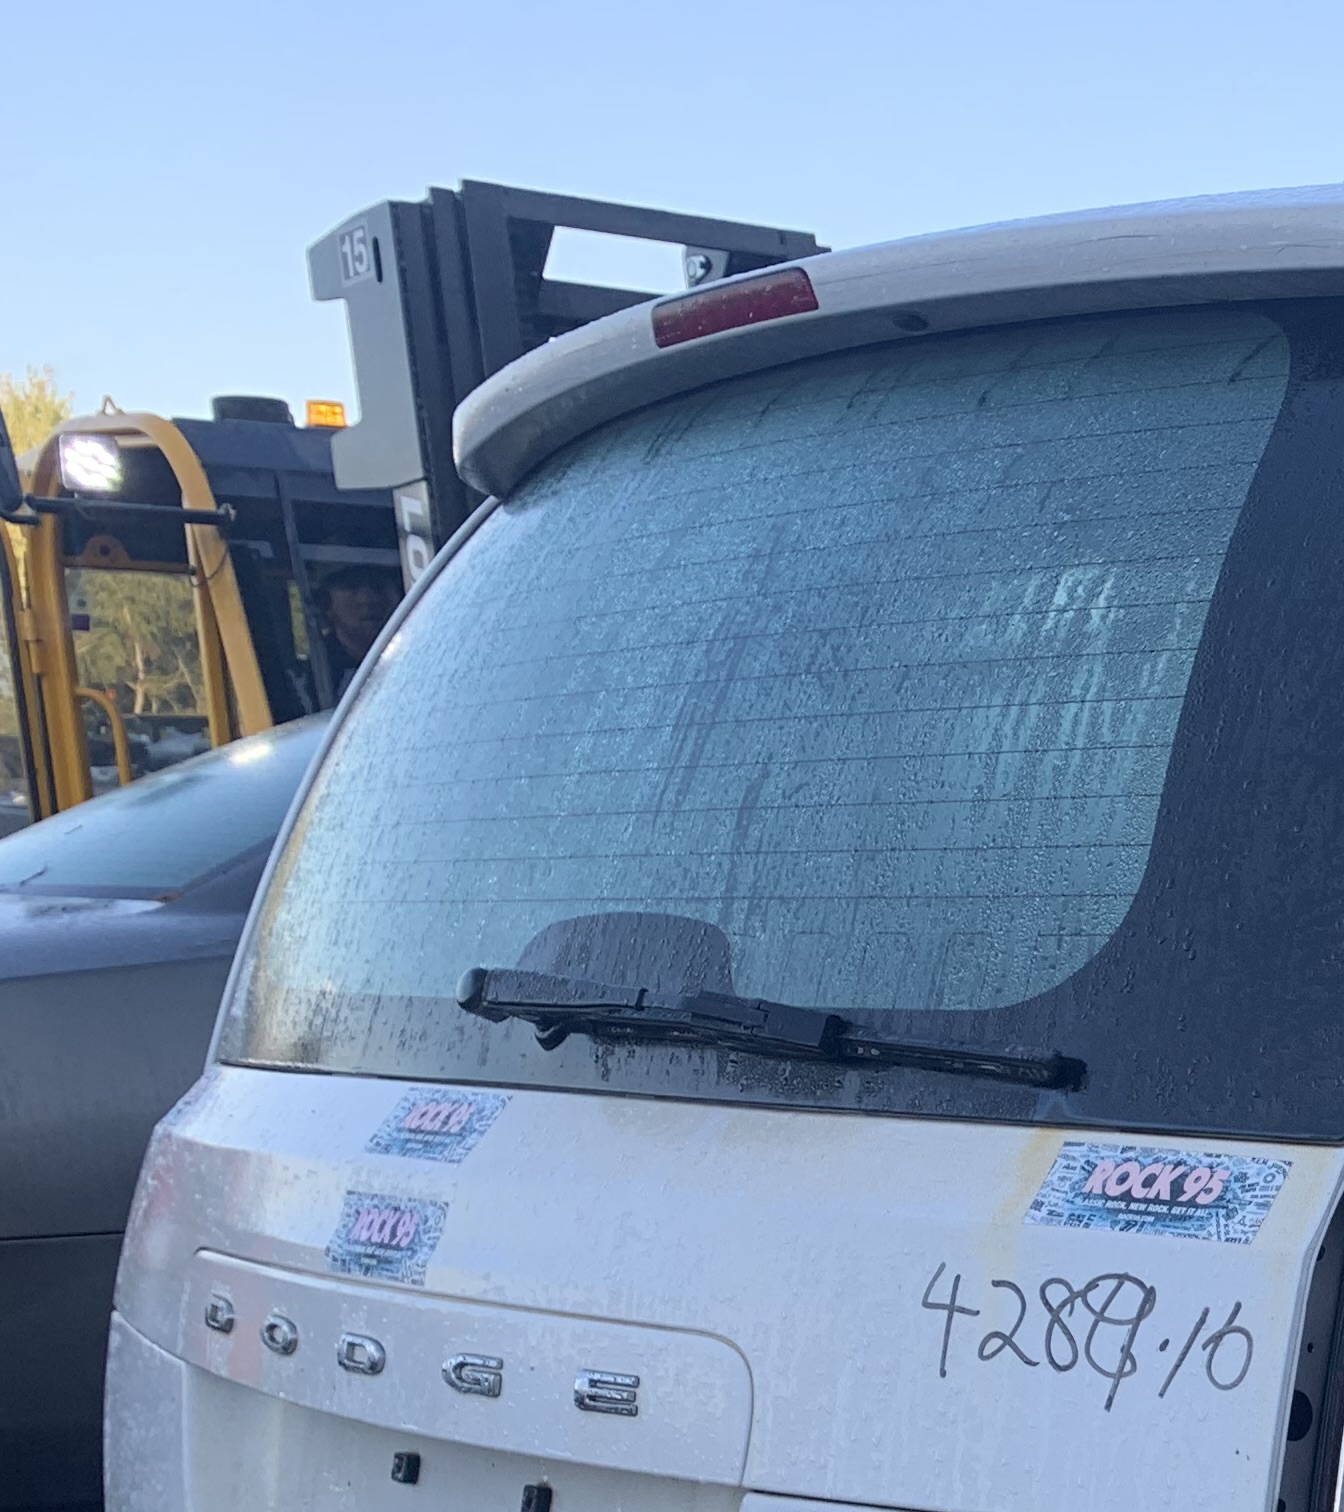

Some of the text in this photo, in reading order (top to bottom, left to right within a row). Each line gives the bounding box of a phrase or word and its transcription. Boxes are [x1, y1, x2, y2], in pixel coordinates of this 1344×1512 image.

[341, 228, 370, 277] 15
[1083, 1158, 1187, 1202] ROCK
[1175, 1167, 1233, 1206] 95
[204, 1291, 641, 1418] DODGE
